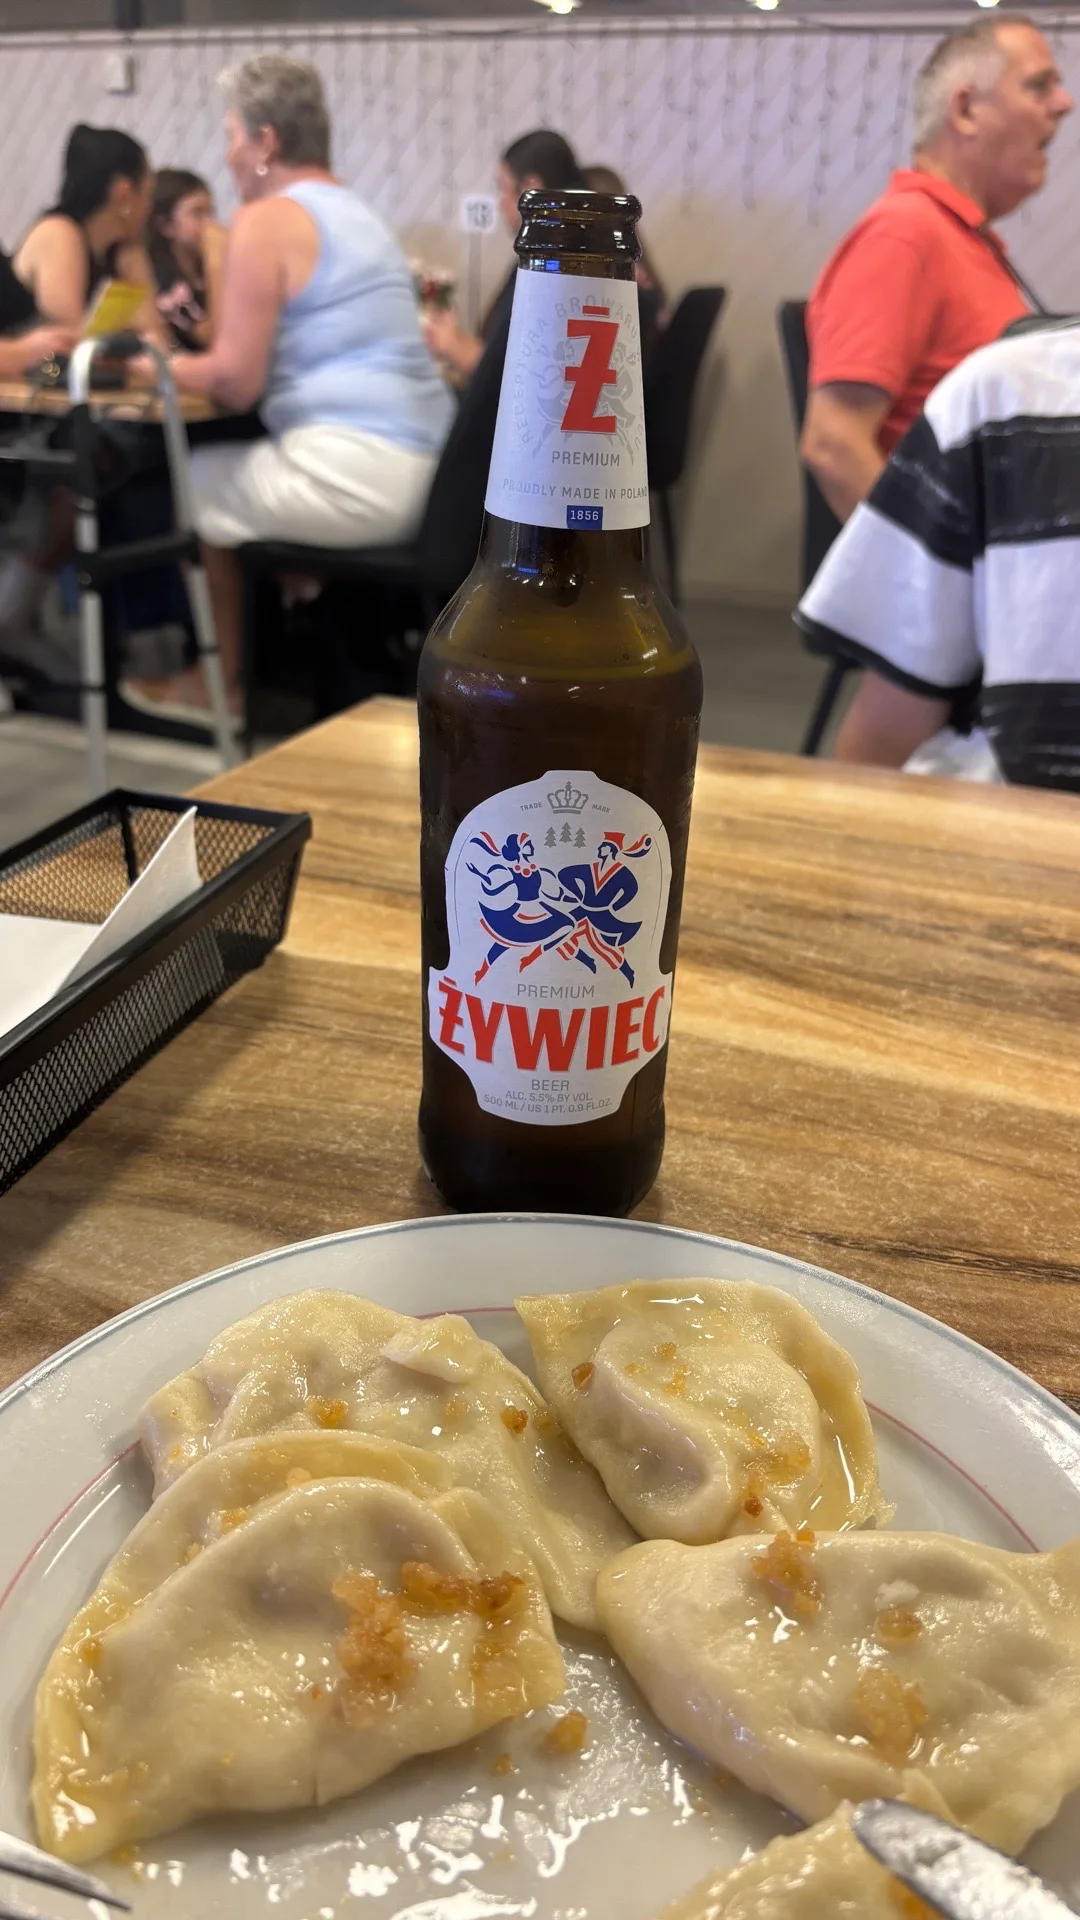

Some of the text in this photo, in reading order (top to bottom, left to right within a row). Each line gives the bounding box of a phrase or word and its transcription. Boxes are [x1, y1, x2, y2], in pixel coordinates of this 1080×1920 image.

[551, 450, 620, 467] PREMIUM
[503, 478, 557, 497] PROUDLY
[562, 487, 600, 499] MADE
[605, 488, 616, 499] IN
[570, 510, 599, 521] 1856
[520, 801, 611, 814] TRADE MARK
[517, 983, 596, 999] PREMIUM
[438, 975, 666, 1073] ŻYWIEC
[531, 1079, 570, 1092] BEER
[484, 1093, 503, 1107] 500
[505, 1100, 519, 1111] ML
[527, 1104, 542, 1113] US
[551, 1104, 566, 1114] PT.
[568, 1103, 584, 1113] 0.9
[505, 1090, 593, 1103] ALC. 5.5% BY VOL.
